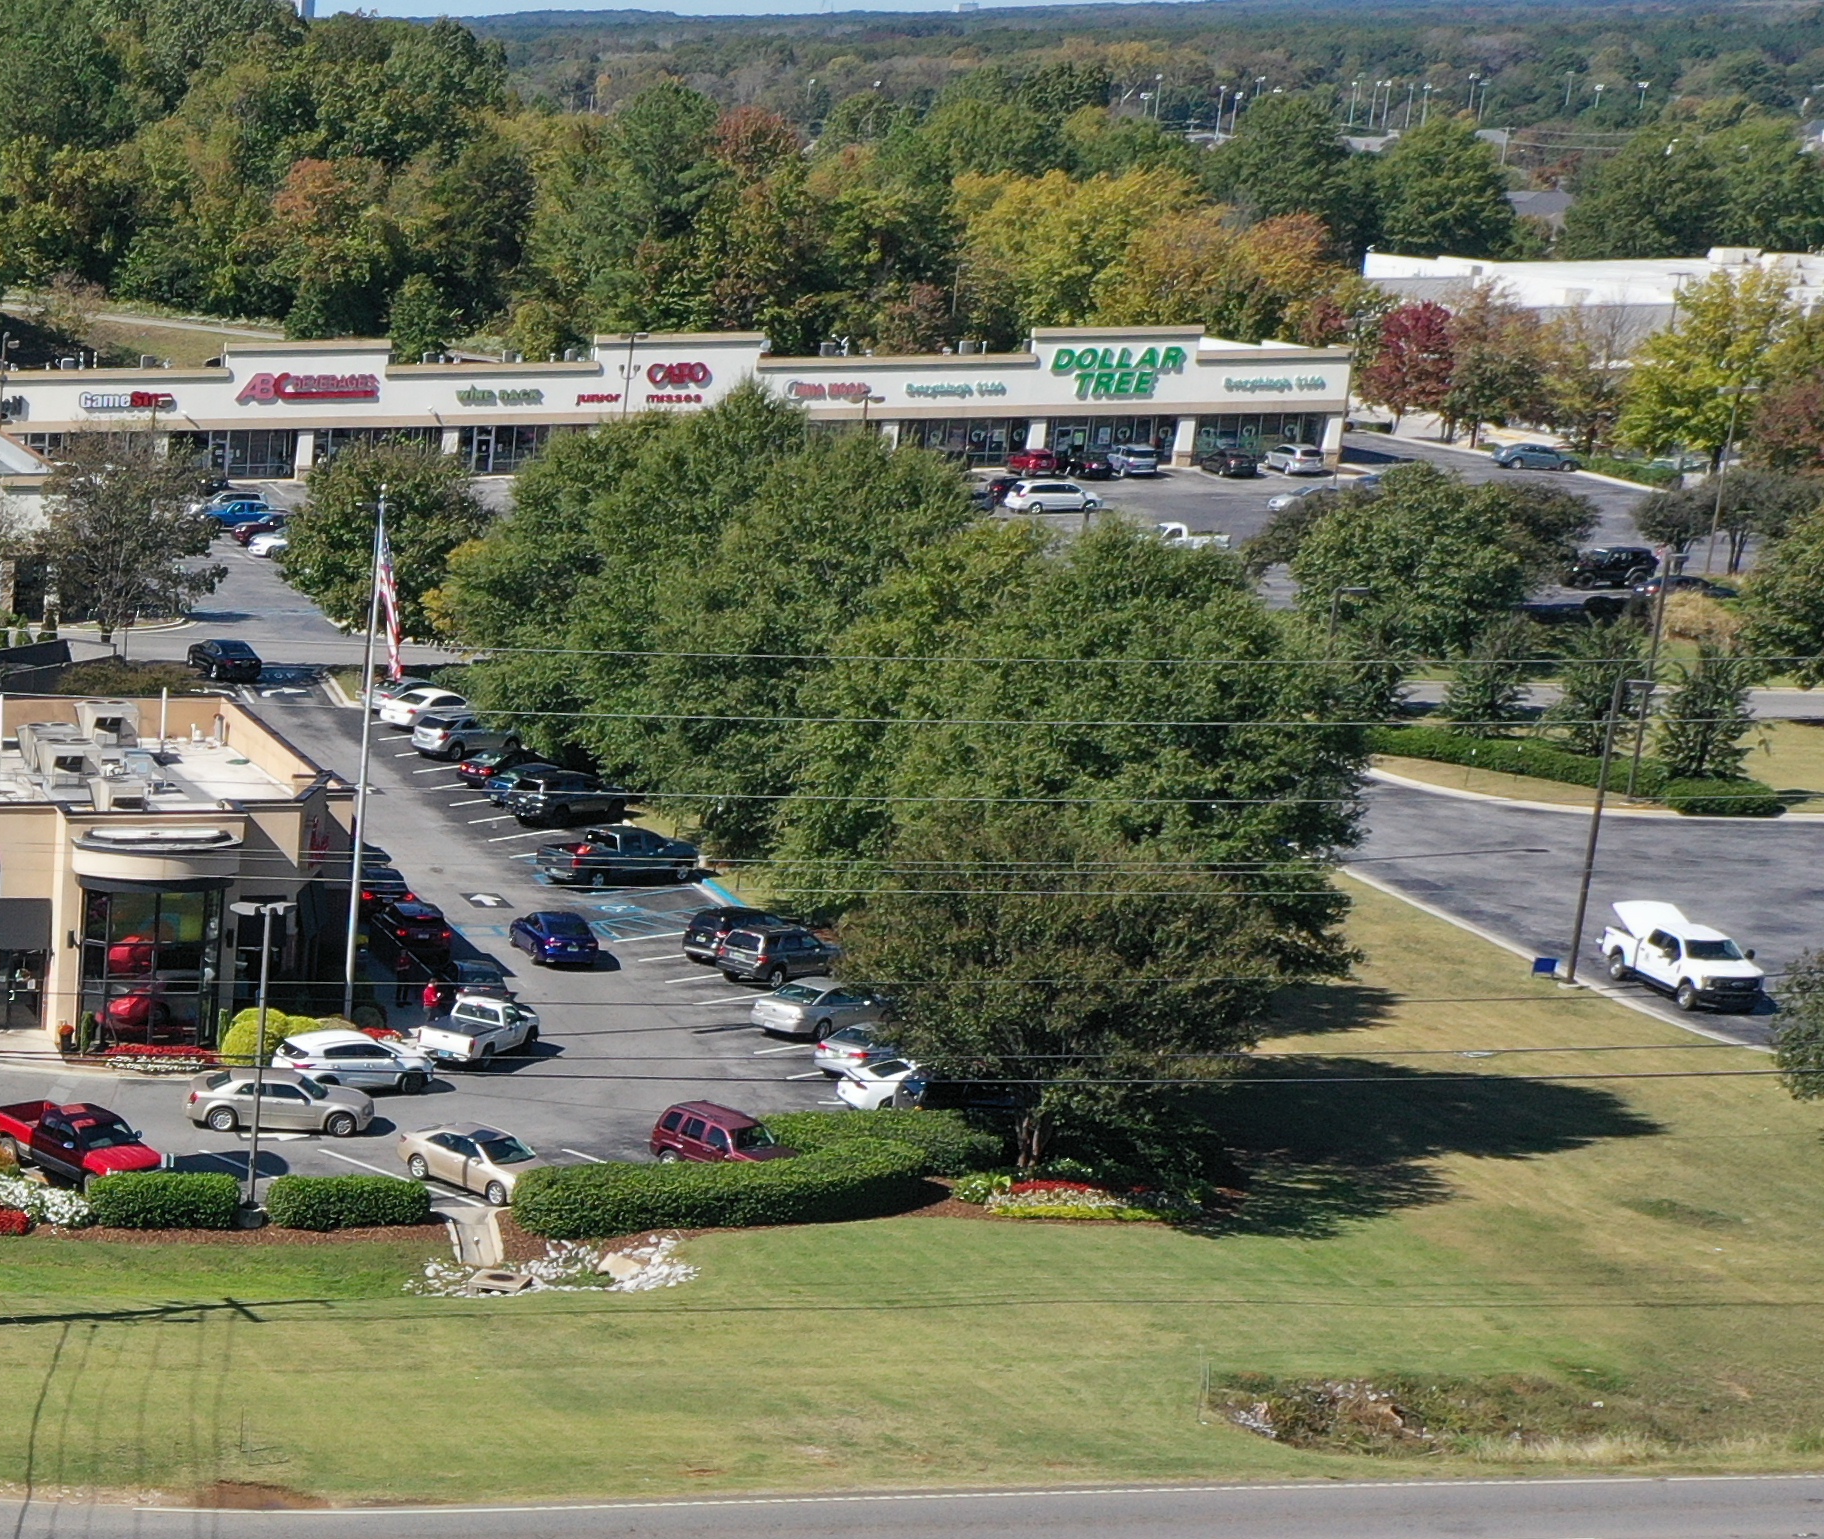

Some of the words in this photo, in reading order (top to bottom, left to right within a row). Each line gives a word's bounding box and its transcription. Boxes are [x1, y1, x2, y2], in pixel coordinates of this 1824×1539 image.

[1050, 346, 1185, 372] DOLLAR
[647, 362, 710, 385] CATO
[1073, 371, 1153, 396] TREE
[236, 373, 292, 402] ABC
[292, 373, 379, 392] BEVERAGES
[455, 383, 495, 402] WINE
[498, 388, 542, 402] RACK
[577, 392, 622, 406] junior
[646, 393, 702, 403] misses
